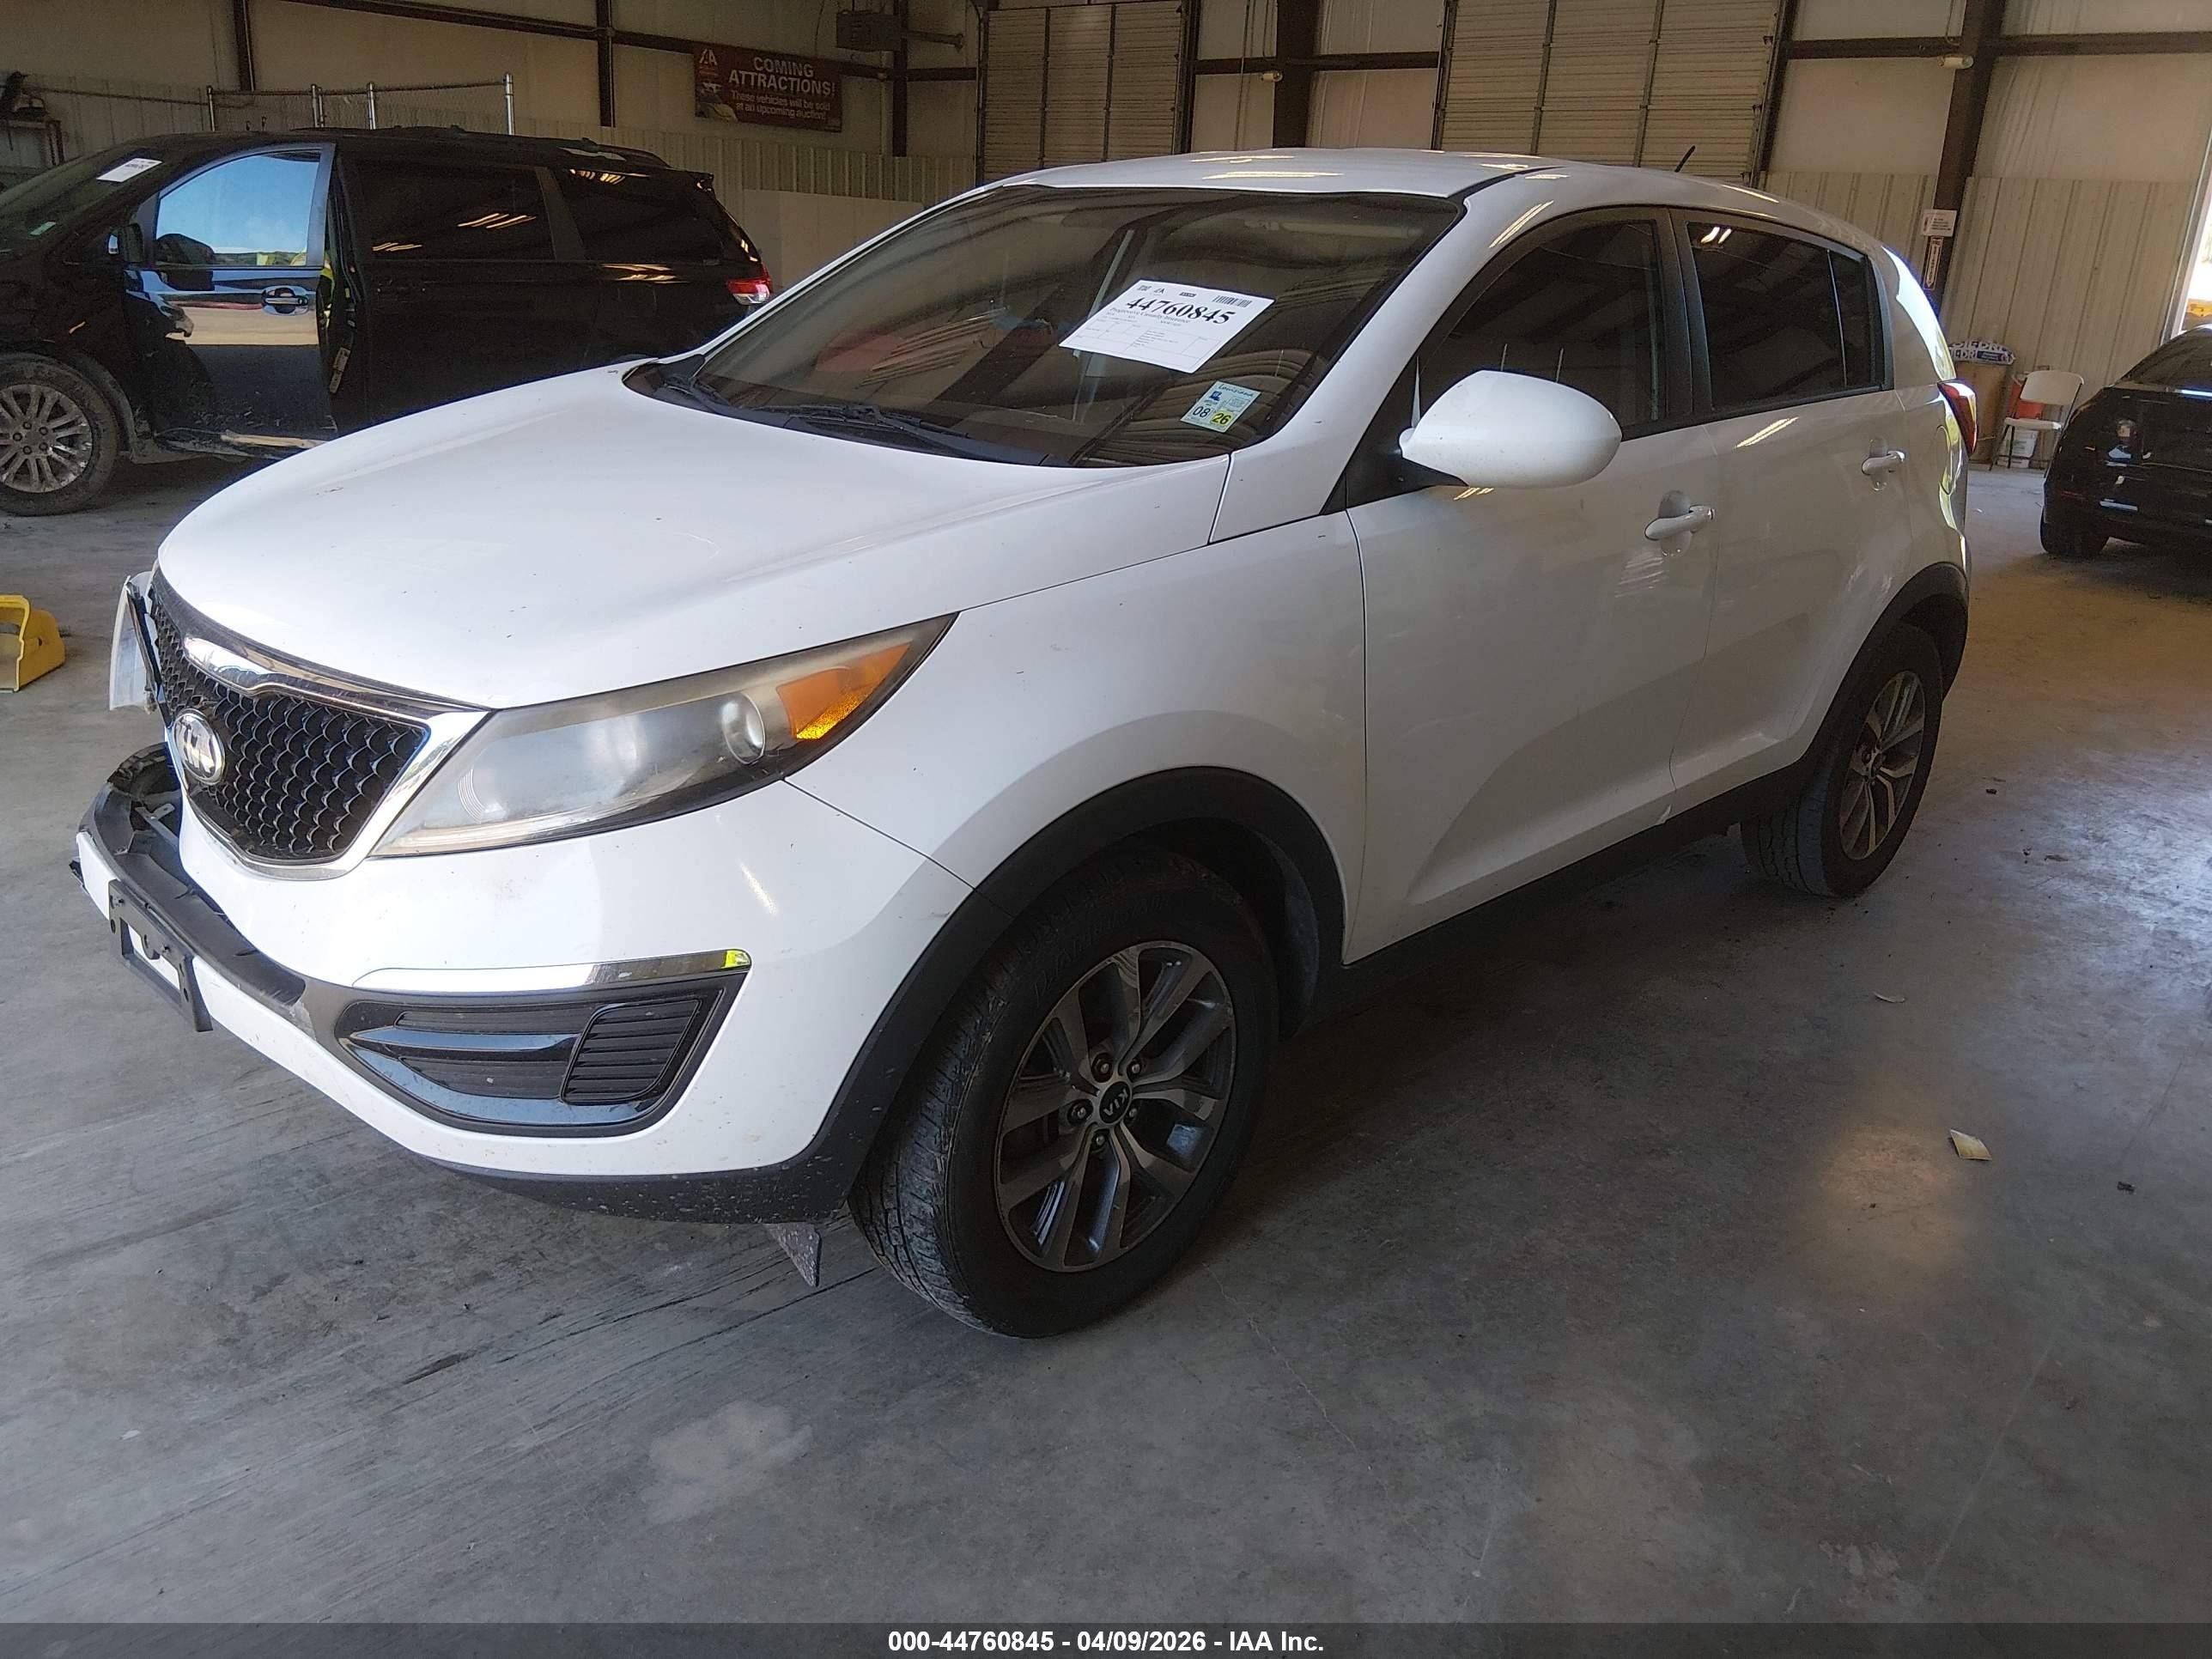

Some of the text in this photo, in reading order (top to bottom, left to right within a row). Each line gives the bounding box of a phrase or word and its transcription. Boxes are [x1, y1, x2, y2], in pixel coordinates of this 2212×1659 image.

[754, 57, 813, 77] COMING
[728, 70, 835, 97] ATTRACTIONS!
[731, 89, 830, 111] These vehicles will be sold
[744, 103, 755, 112] an
[757, 104, 795, 118] upcoming
[796, 110, 826, 120] auction!
[1126, 297, 1237, 325] 44760845
[1218, 384, 1255, 397] Louisiana
[1192, 406, 1211, 418] 08
[1212, 412, 1232, 425] 26
